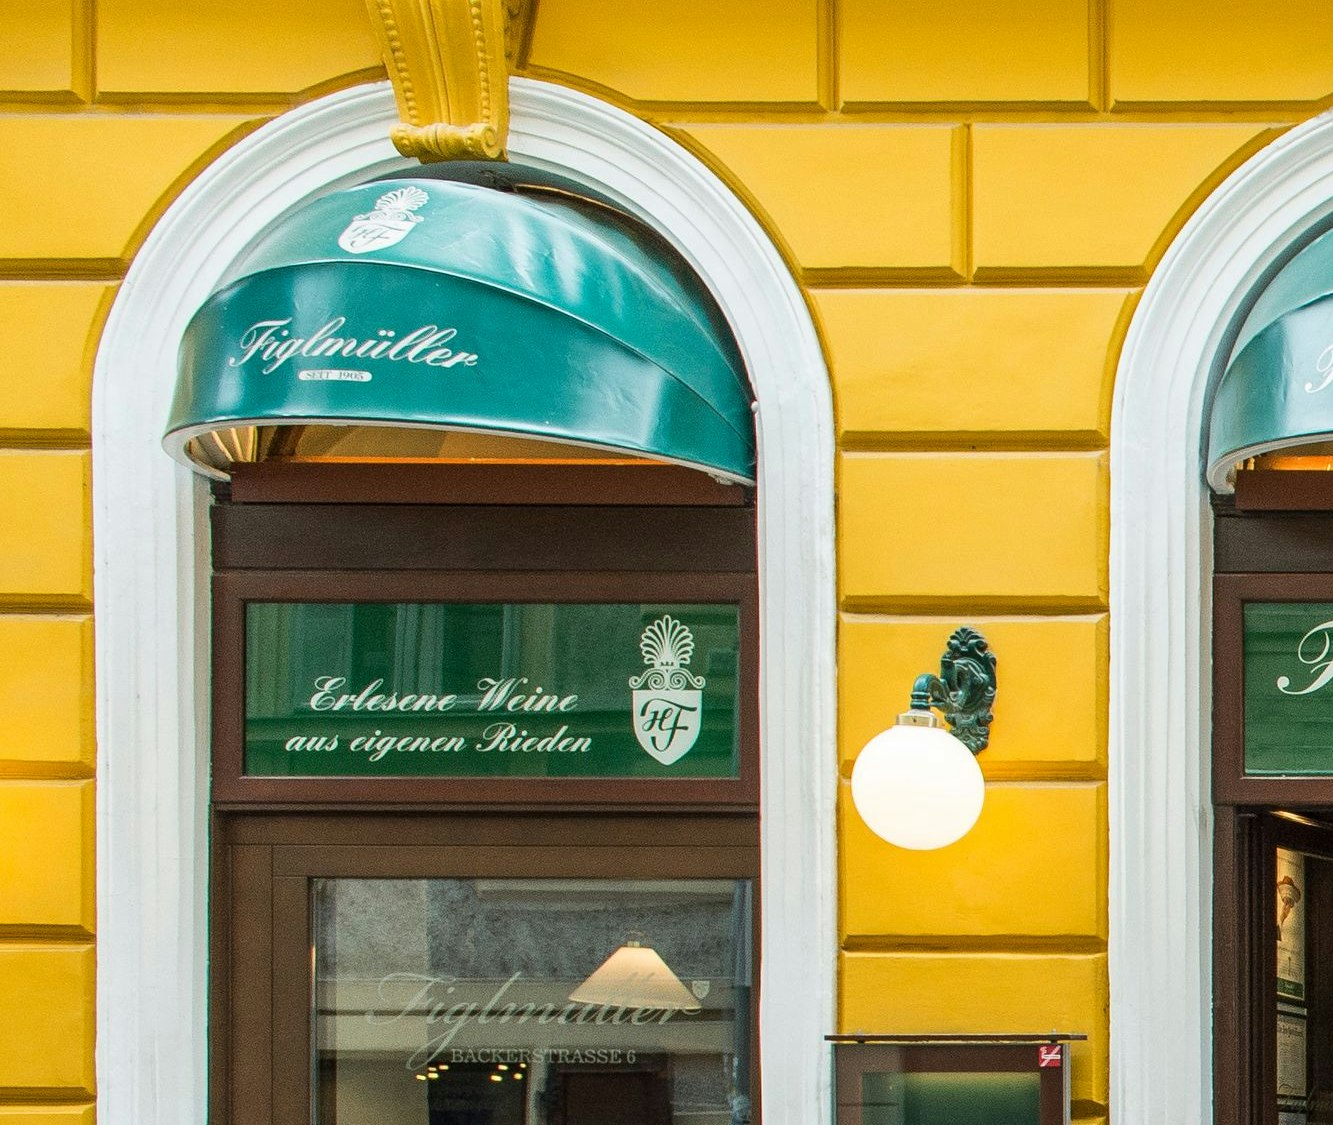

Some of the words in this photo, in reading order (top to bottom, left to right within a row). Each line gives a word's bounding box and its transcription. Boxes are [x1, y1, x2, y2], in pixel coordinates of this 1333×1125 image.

[227, 317, 478, 374] Figlmüller
[309, 676, 457, 713] Erlesene
[476, 676, 578, 713] Weine
[285, 731, 339, 754] aus
[349, 727, 467, 762] eigenen
[475, 721, 592, 754] Rieden
[626, 1048, 636, 1065] 6
